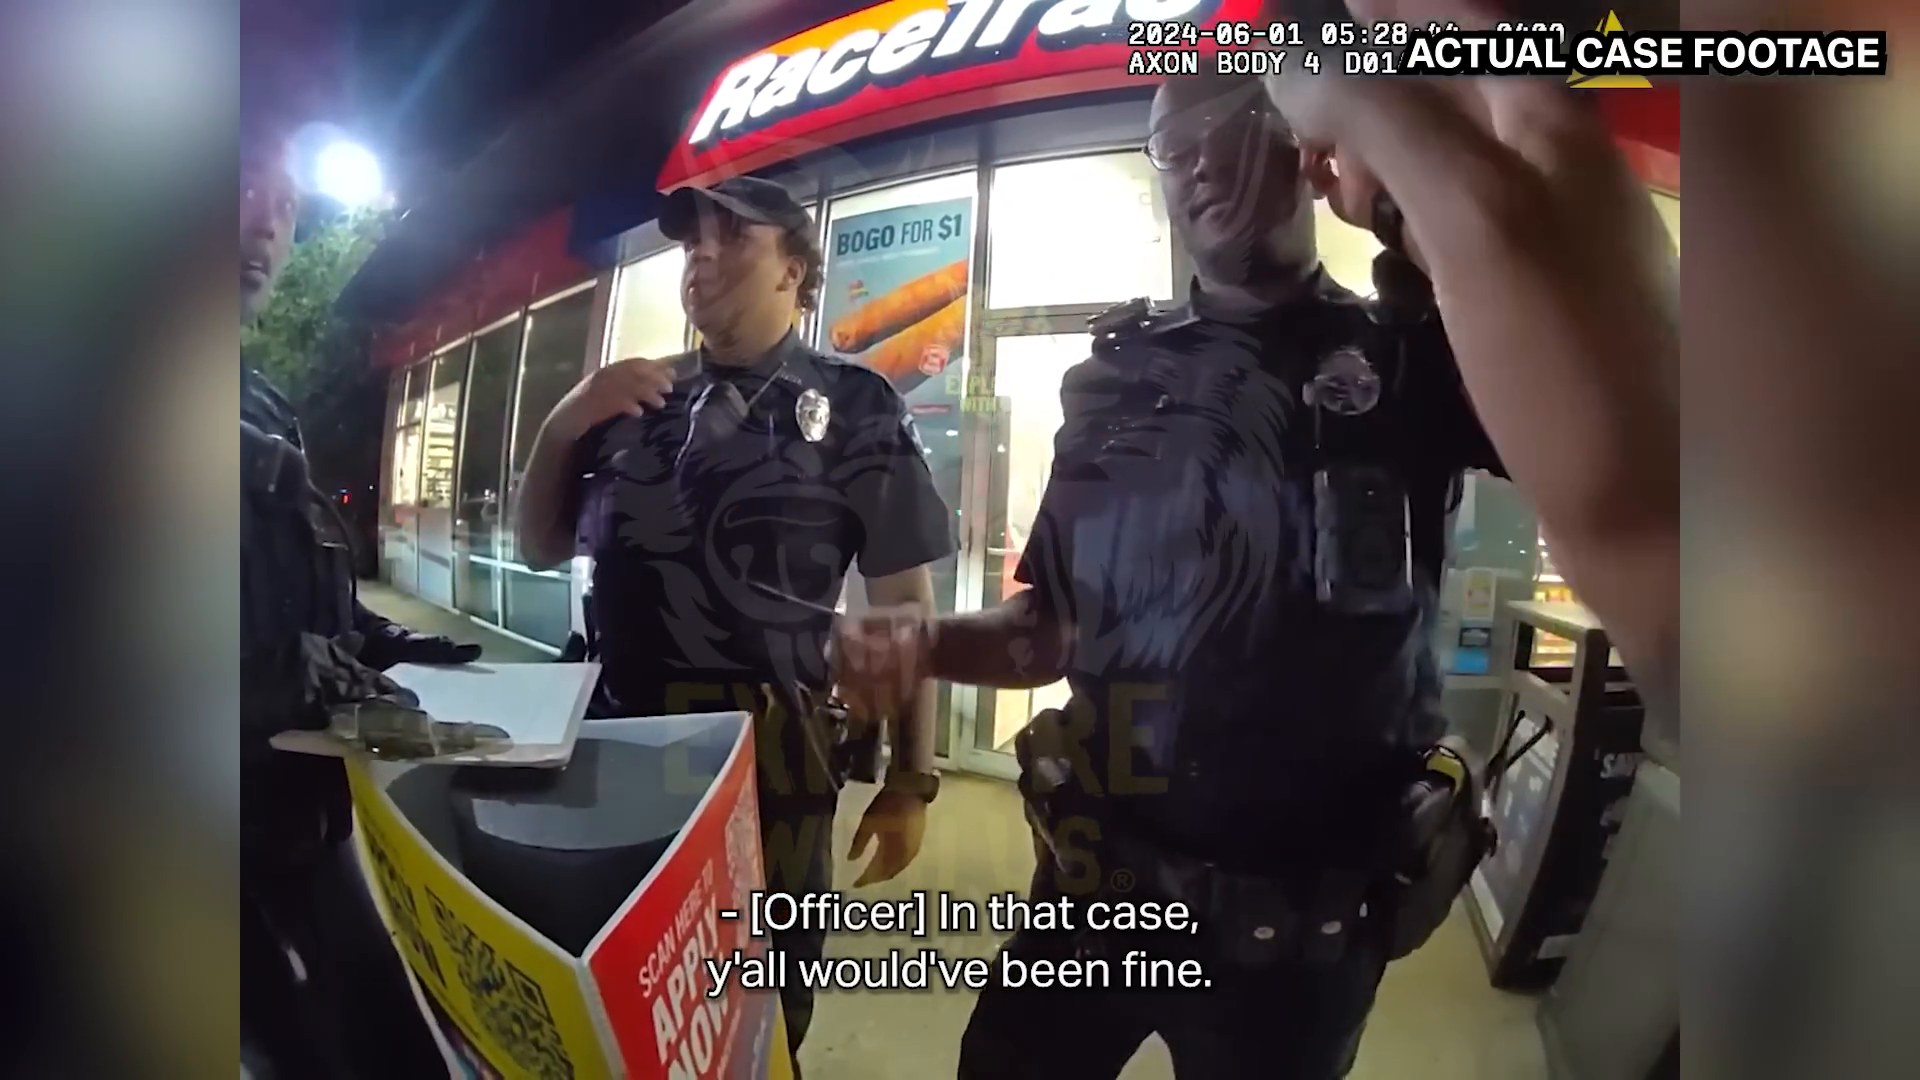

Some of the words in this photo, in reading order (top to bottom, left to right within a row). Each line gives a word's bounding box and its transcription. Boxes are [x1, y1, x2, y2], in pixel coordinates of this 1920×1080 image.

[836, 225, 895, 256] BOGO
[901, 218, 934, 245] FOR
[938, 213, 963, 241] $1
[639, 926, 676, 998] SCAN
[652, 892, 719, 1066] APPLY
